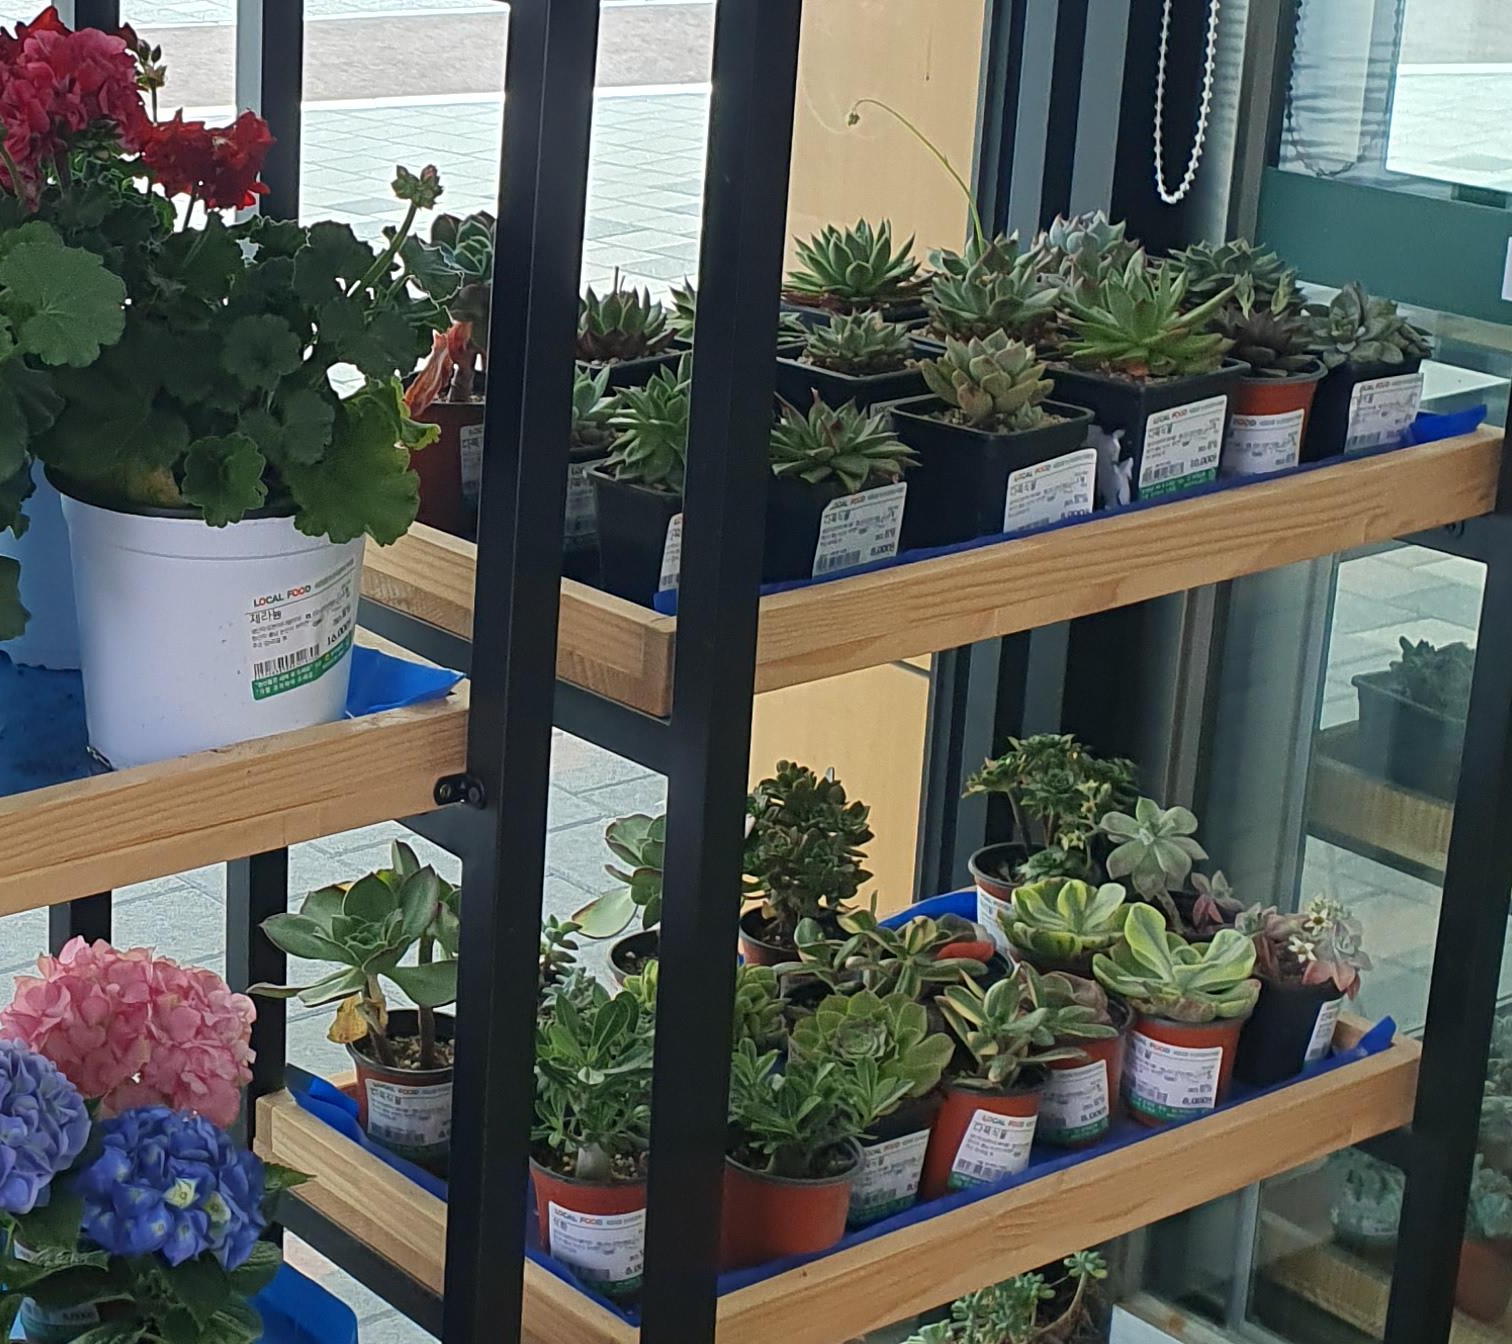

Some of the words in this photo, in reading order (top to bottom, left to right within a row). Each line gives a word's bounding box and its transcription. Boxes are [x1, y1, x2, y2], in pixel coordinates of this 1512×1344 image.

[253, 593, 284, 607] LOCAL
[287, 585, 311, 599] FOOD
[982, 1115, 1006, 1126] LOCAL
